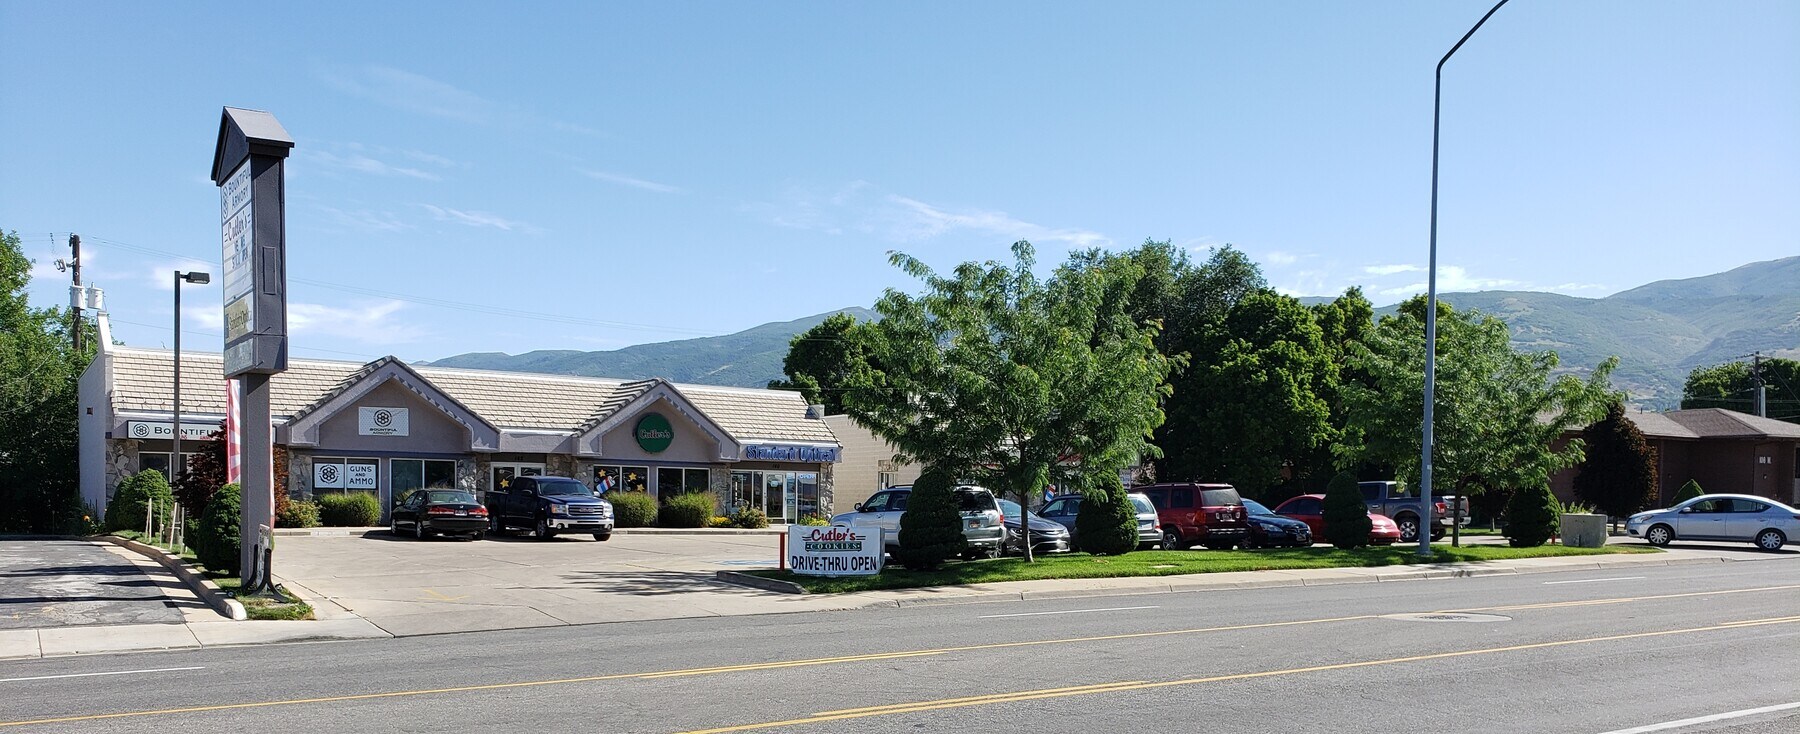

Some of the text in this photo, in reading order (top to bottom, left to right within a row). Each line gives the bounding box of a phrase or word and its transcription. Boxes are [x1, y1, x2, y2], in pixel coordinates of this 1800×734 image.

[227, 210, 248, 241] Cutler's
[746, 445, 836, 463] Standard Optical
[811, 528, 856, 541] Cutler's
[792, 555, 877, 571] DRIVE-THRU OPEN
